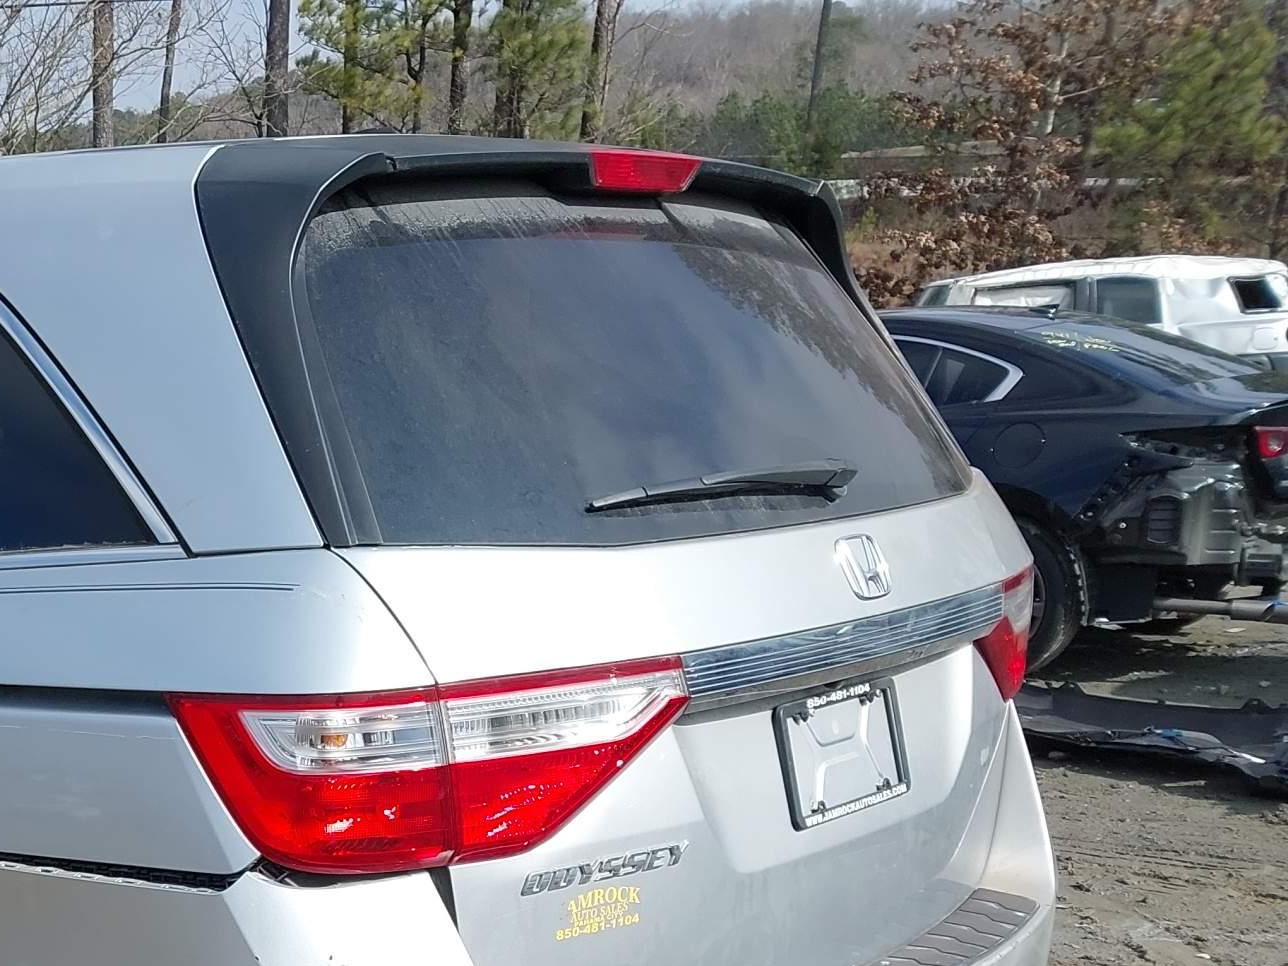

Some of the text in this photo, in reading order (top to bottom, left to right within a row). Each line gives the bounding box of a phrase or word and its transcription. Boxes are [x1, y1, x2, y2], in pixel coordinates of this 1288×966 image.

[806, 682, 871, 709] 850-481-1104
[520, 839, 690, 897] ODYSSEY
[567, 886, 641, 913] AMROCK
[570, 901, 629, 923] AUTO SALES
[556, 912, 640, 941] 850-481-1104
